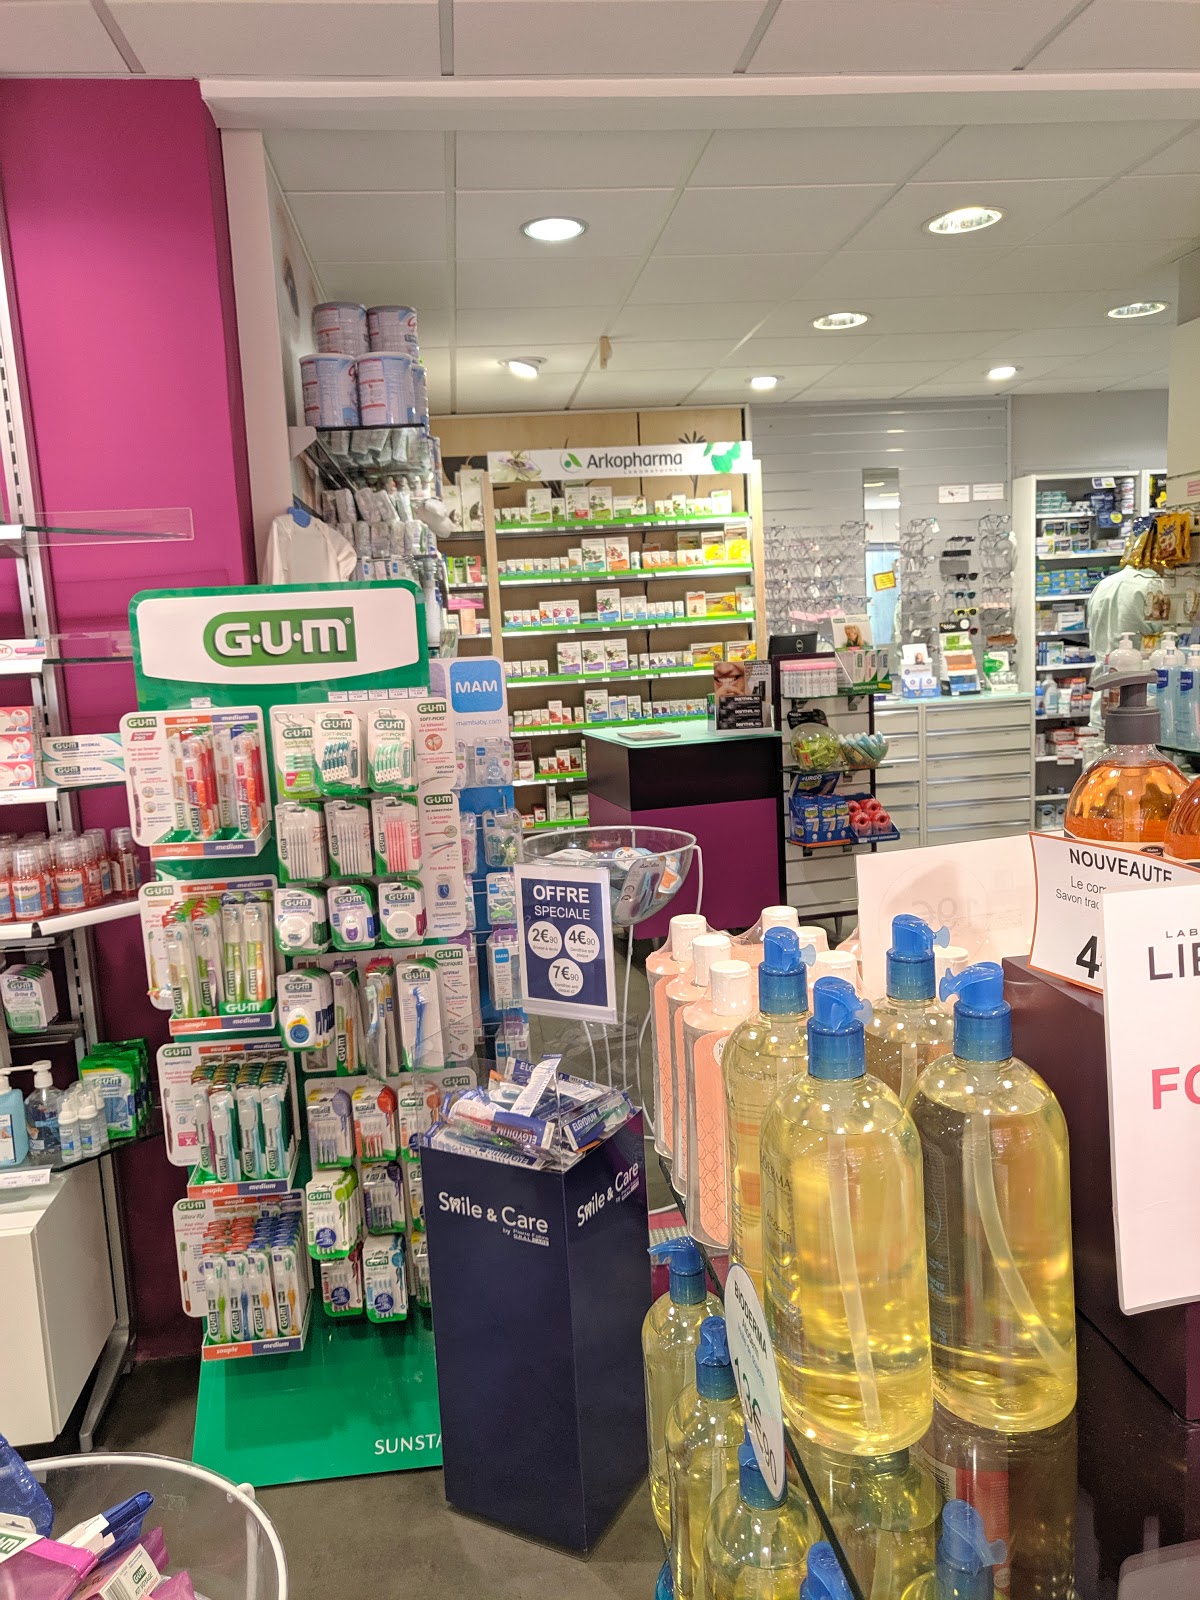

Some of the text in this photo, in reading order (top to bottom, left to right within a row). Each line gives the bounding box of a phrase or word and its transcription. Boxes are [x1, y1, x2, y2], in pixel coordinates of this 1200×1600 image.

[587, 452, 682, 470] Arkopharma
[455, 679, 498, 693] MAM
[215, 842, 244, 851] medium
[1069, 848, 1172, 883] NOUVEAUTE
[1070, 875, 1083, 890] Le
[533, 884, 590, 904] OFFRE
[1055, 888, 1082, 905] Savon
[534, 904, 591, 920] SPECIALE
[233, 1017, 261, 1025] medium
[572, 1111, 598, 1132] ELGYDIUM
[496, 1127, 538, 1144] ELGYDIUM
[248, 1183, 276, 1191] medium
[577, 1162, 639, 1227] Smile & Care
[438, 1191, 549, 1234] Smile & Care
[502, 1227, 511, 1236] by
[733, 1280, 768, 1360] BIODERMA
